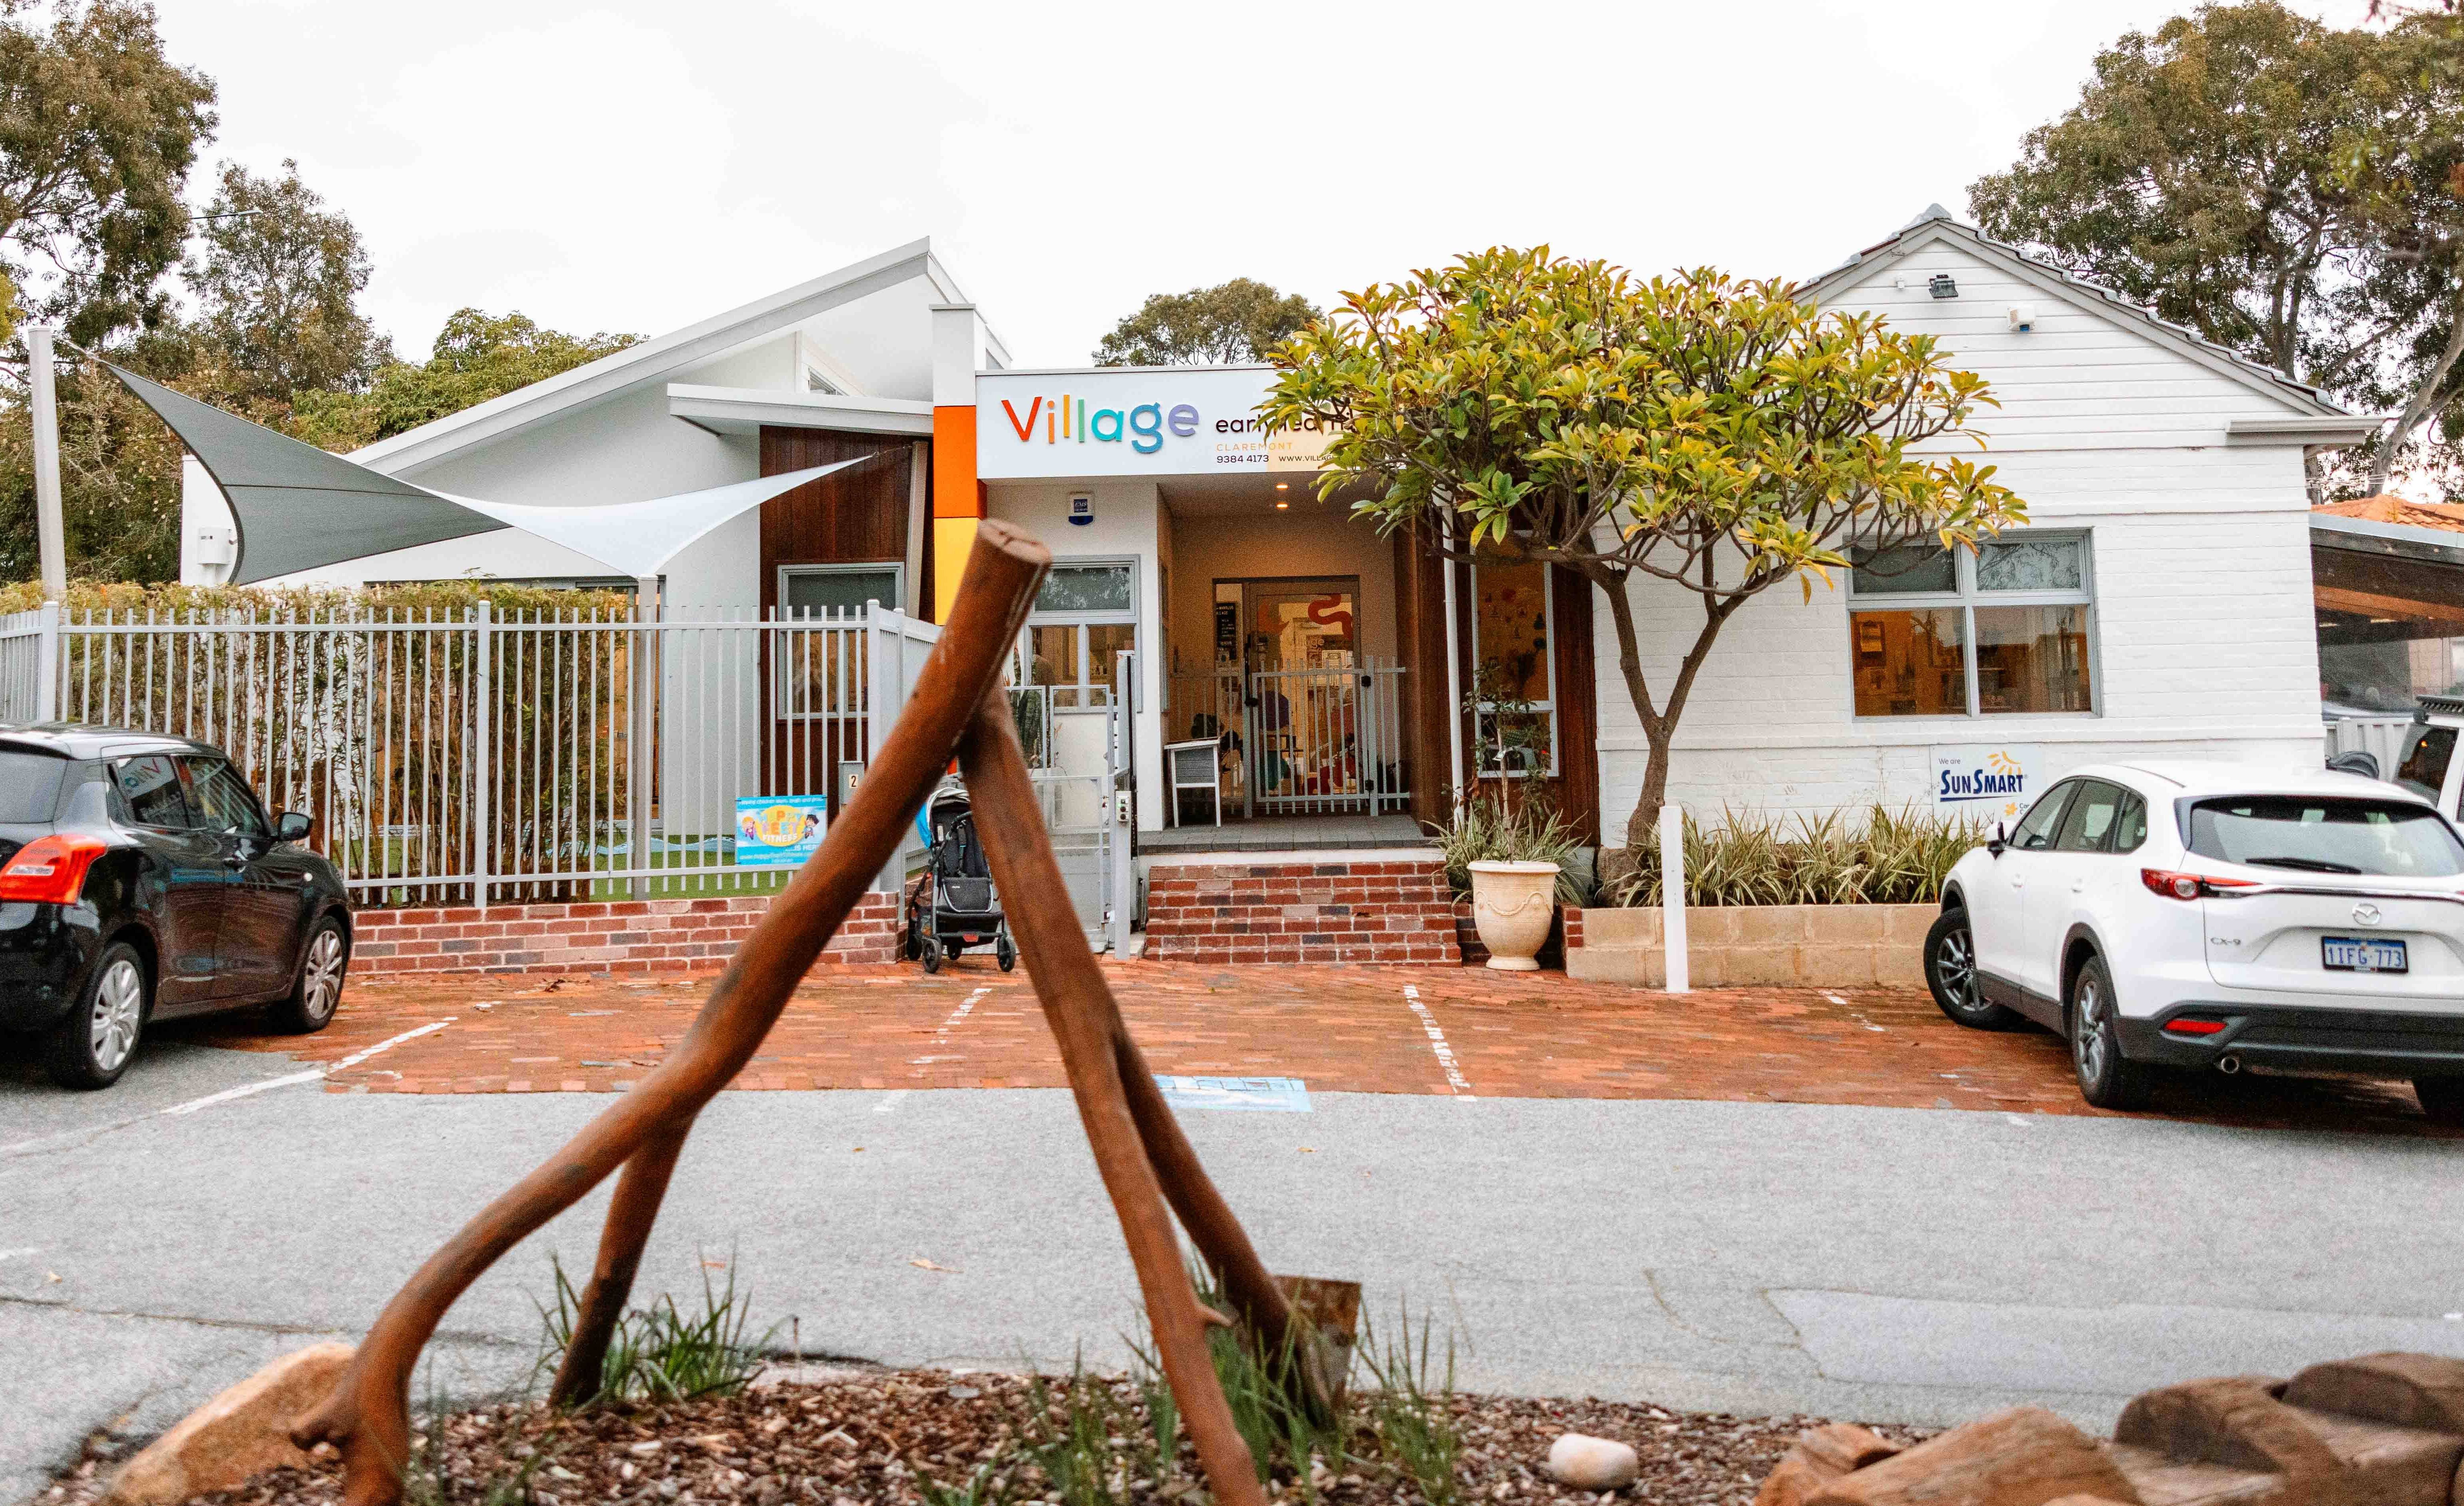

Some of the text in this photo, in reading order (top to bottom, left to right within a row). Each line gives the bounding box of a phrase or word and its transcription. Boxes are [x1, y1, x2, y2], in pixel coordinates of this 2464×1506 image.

[1001, 394, 1199, 454] Village
[1217, 443, 1292, 451] CLAREMONT
[851, 776, 856, 787] 2
[763, 833, 798, 843] FITNESS
[2211, 937, 2241, 946] CX-9
